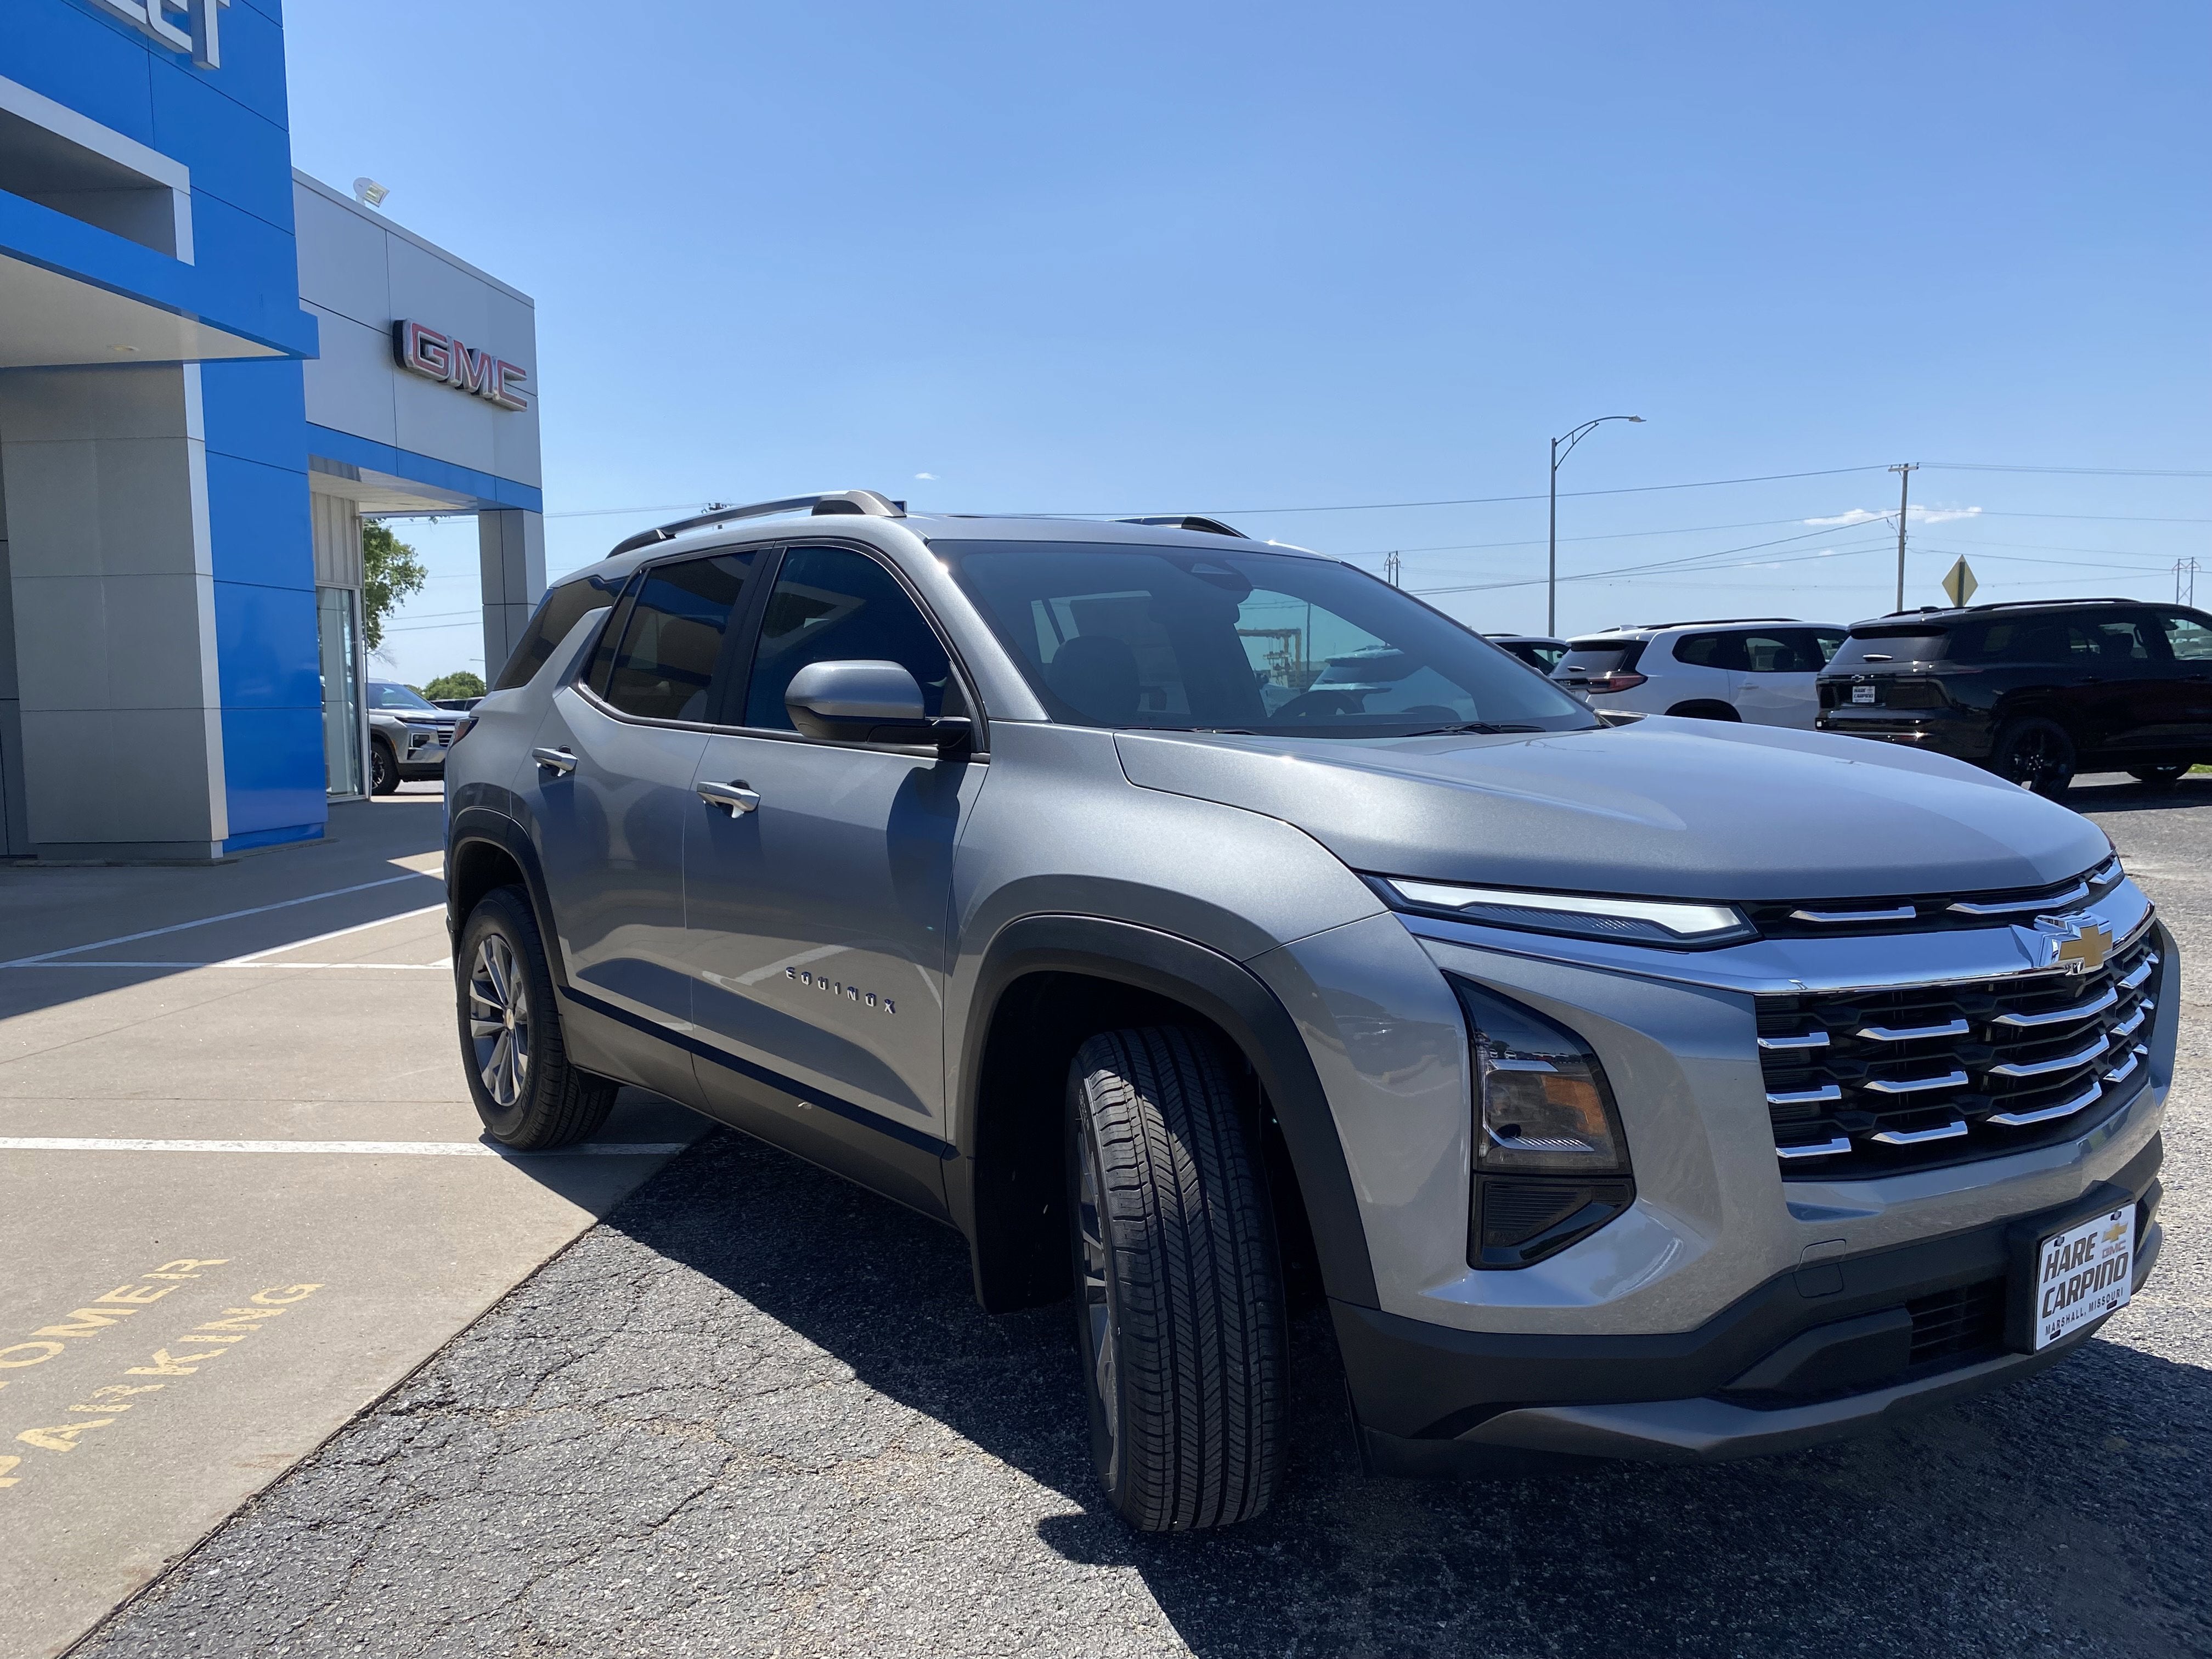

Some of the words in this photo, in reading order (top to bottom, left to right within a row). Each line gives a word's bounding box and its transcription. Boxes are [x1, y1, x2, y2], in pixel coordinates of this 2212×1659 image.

[393, 318, 528, 412] GMC
[786, 967, 896, 1014] EQUINOX
[2043, 1232, 2098, 1284] HARE
[2102, 1239, 2126, 1259] GMC
[2042, 1252, 2129, 1319] CARPINO
[2045, 1307, 2086, 1335] MARSHALL,
[2088, 1286, 2124, 1313] MISSOURI
[0, 1258, 229, 1388] OMER
